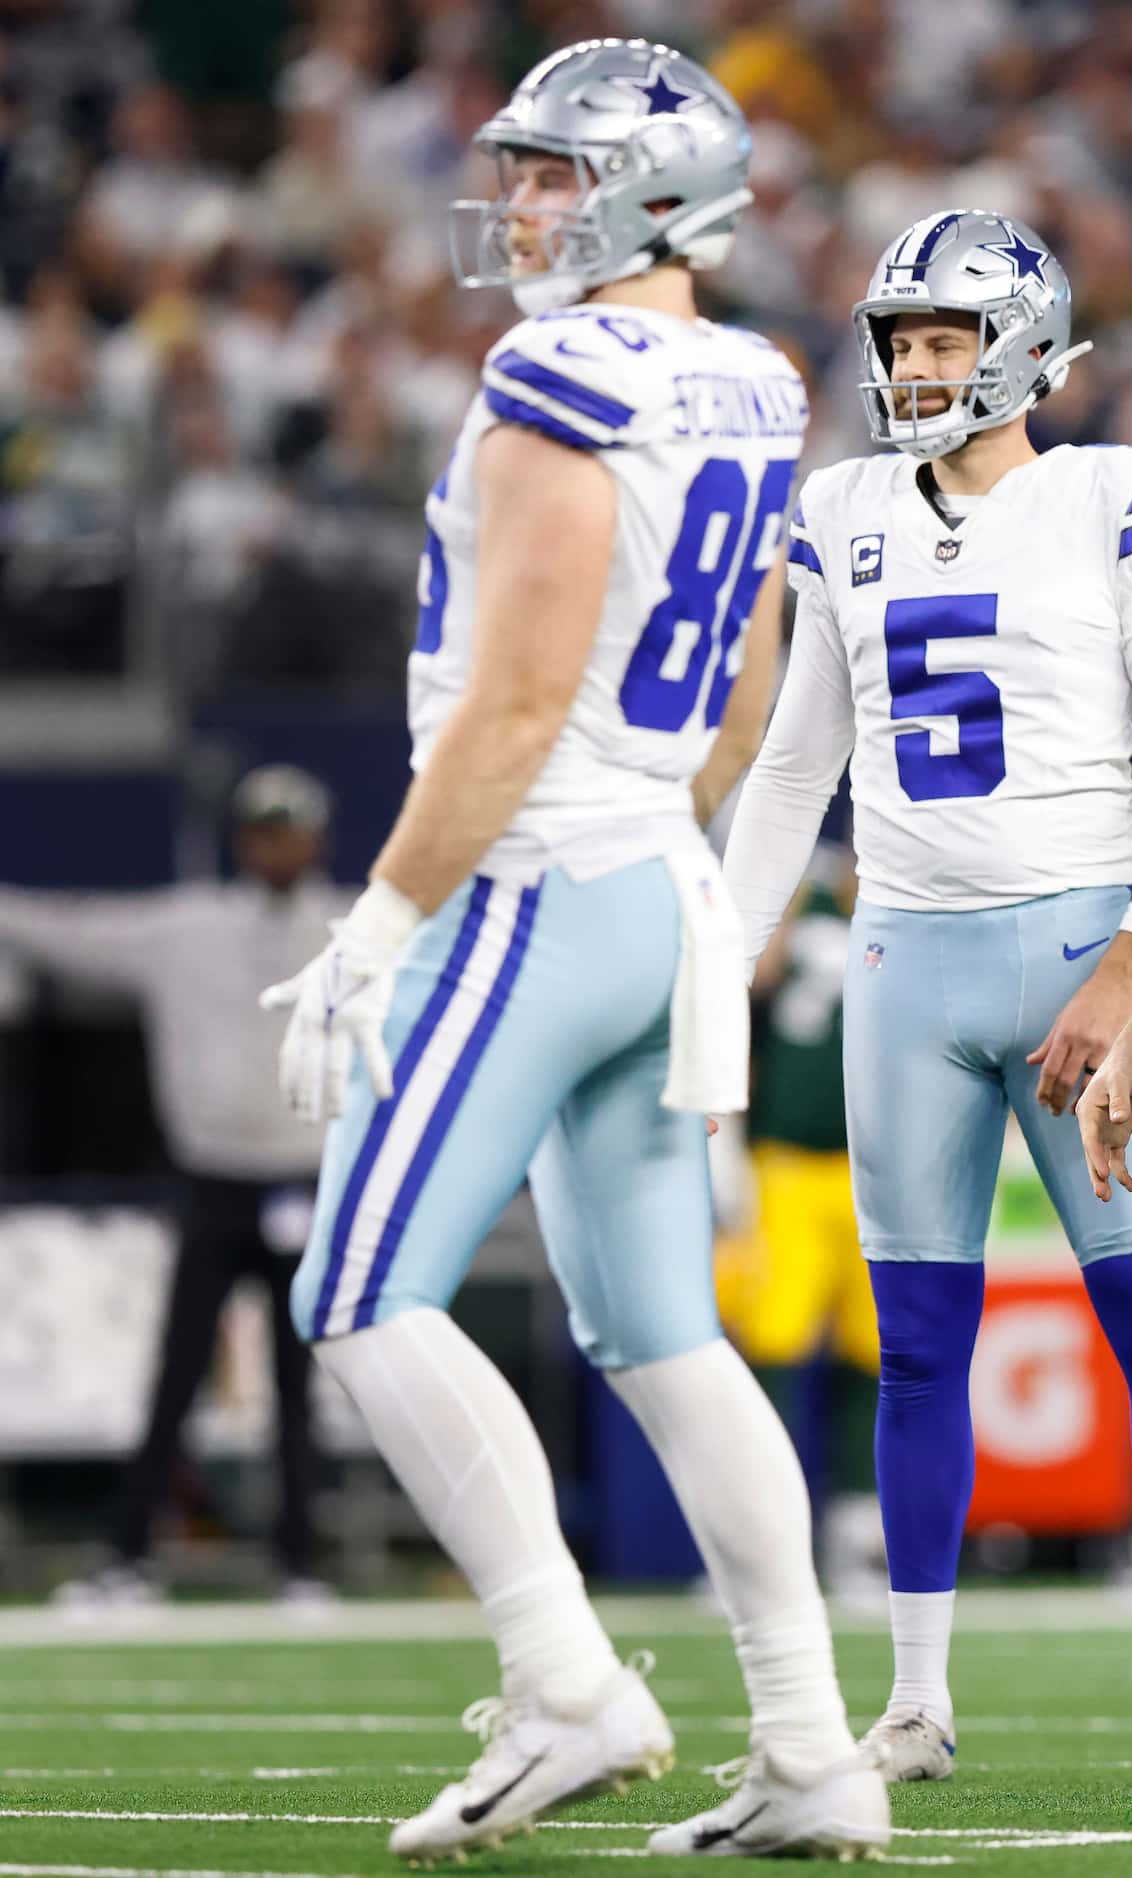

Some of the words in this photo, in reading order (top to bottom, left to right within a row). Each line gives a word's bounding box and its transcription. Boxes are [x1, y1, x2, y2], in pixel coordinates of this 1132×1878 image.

[619, 457, 797, 732] 86
[851, 535, 882, 572] C
[884, 592, 1006, 802] 5
[969, 1297, 1098, 1468] G
